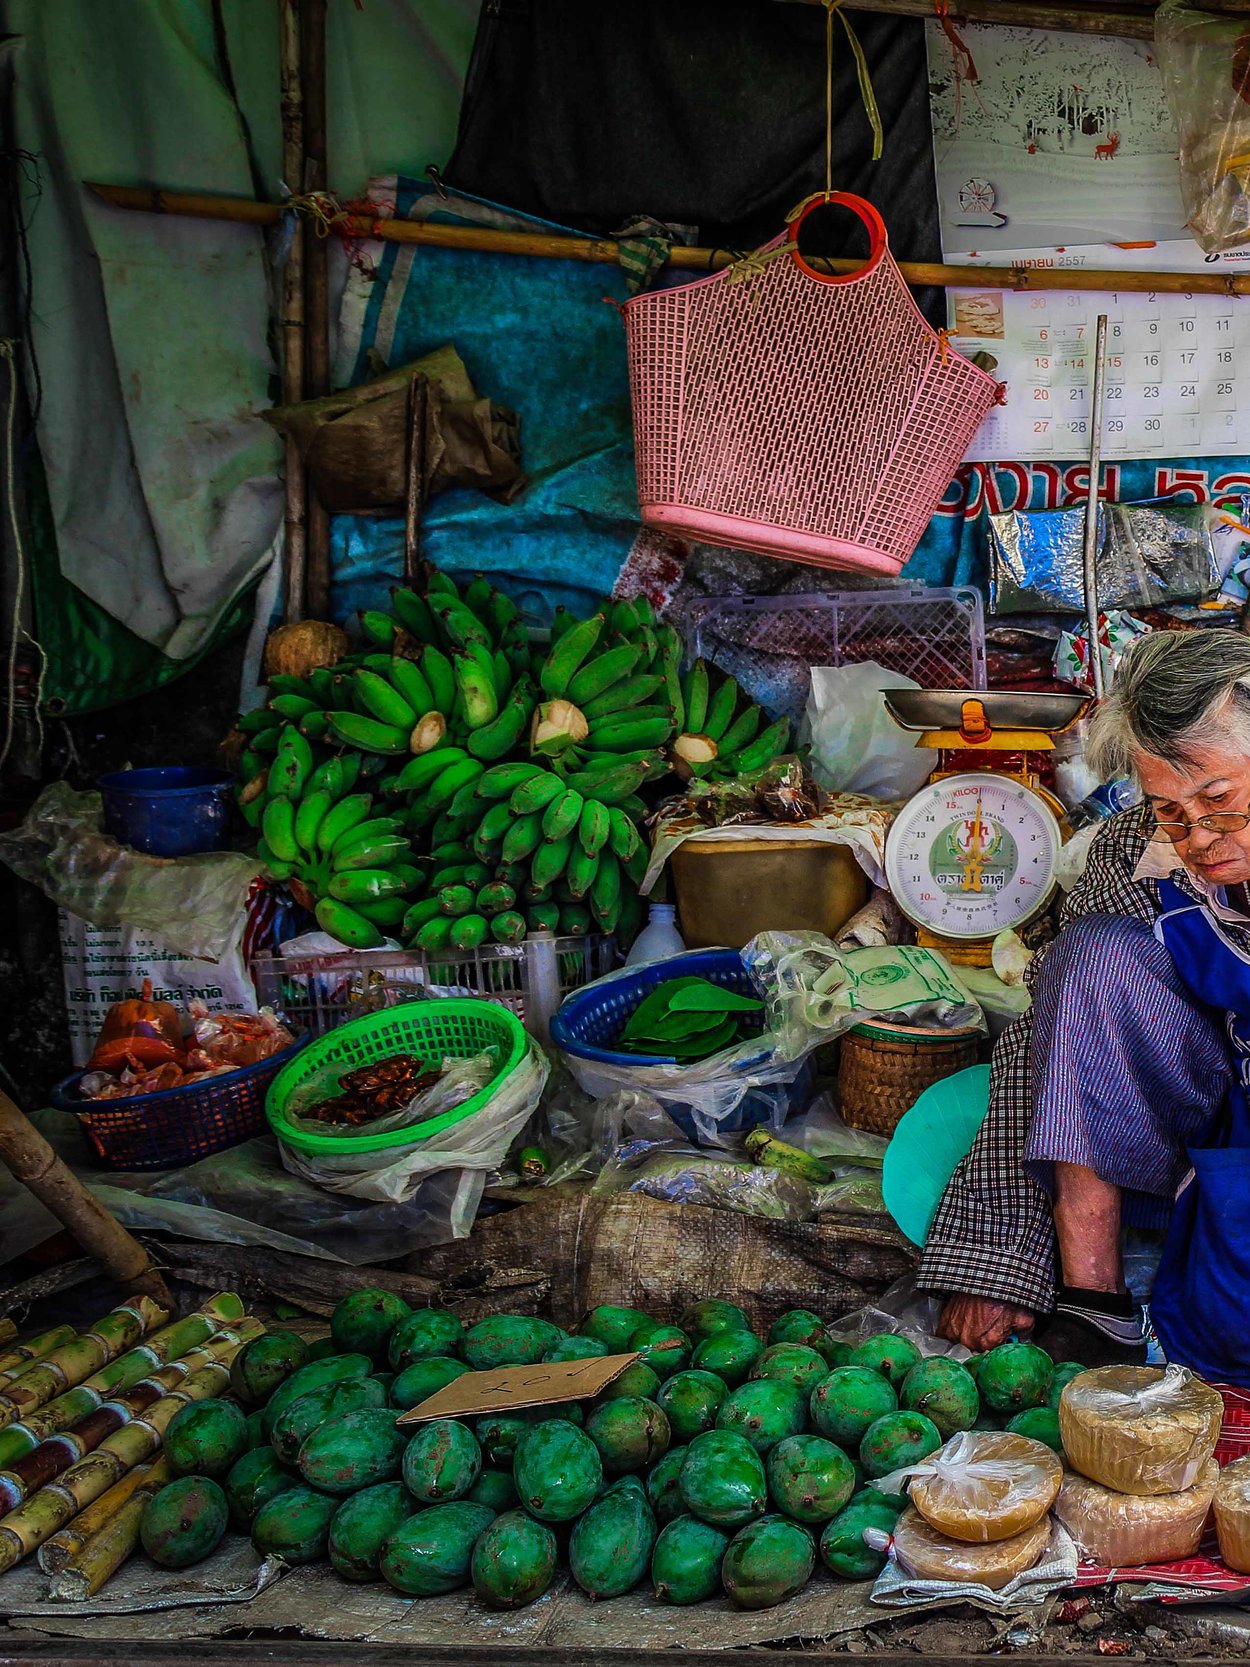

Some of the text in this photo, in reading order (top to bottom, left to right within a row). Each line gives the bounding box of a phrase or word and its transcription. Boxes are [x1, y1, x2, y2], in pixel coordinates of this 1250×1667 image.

[1058, 255, 1086, 267] 2557
[1030, 297, 1047, 309] 30
[1066, 295, 1081, 307] 31
[1112, 293, 1118, 304] 1
[1148, 292, 1156, 303] 2
[1039, 329, 1048, 340] 6
[1075, 328, 1084, 339] 7
[1113, 325, 1121, 337] 8
[1149, 323, 1158, 334] 9
[1179, 320, 1194, 332] 10
[1216, 319, 1229, 331] 11
[1034, 358, 1049, 369] 13
[1070, 358, 1085, 369] 14
[1107, 357, 1122, 368] 15
[1143, 355, 1159, 366] 16
[1180, 352, 1195, 364] 17
[1217, 351, 1232, 363] 18
[1033, 388, 1049, 400] 20
[1069, 388, 1084, 400] 21
[1106, 388, 1122, 399] 22
[1143, 387, 1159, 398] 23
[1180, 385, 1196, 397] 24
[1217, 383, 1233, 395] 25
[1033, 421, 1049, 433] 27
[1070, 421, 1087, 433] 28
[1107, 420, 1124, 432] 29
[1144, 419, 1161, 431] 30
[1225, 415, 1233, 426] 2
[945, 801, 957, 810] 15
[1001, 803, 1006, 811] 1
[925, 814, 936, 823] 14
[949, 810, 1005, 824] TWIN DOL BRAND
[1018, 816, 1025, 825] 2
[916, 831, 926, 839] 13
[1030, 834, 1036, 842] 3
[909, 853, 920, 861] 12
[1032, 856, 1038, 864] 4
[912, 875, 921, 883] 11
[1019, 876, 1026, 885] 5
[919, 892, 931, 901] 10
[1014, 897, 1021, 905] 6
[941, 907, 948, 916] 9
[992, 909, 999, 917] 7
[966, 913, 973, 921] 8
[153, 984, 184, 1001] มิลล์
